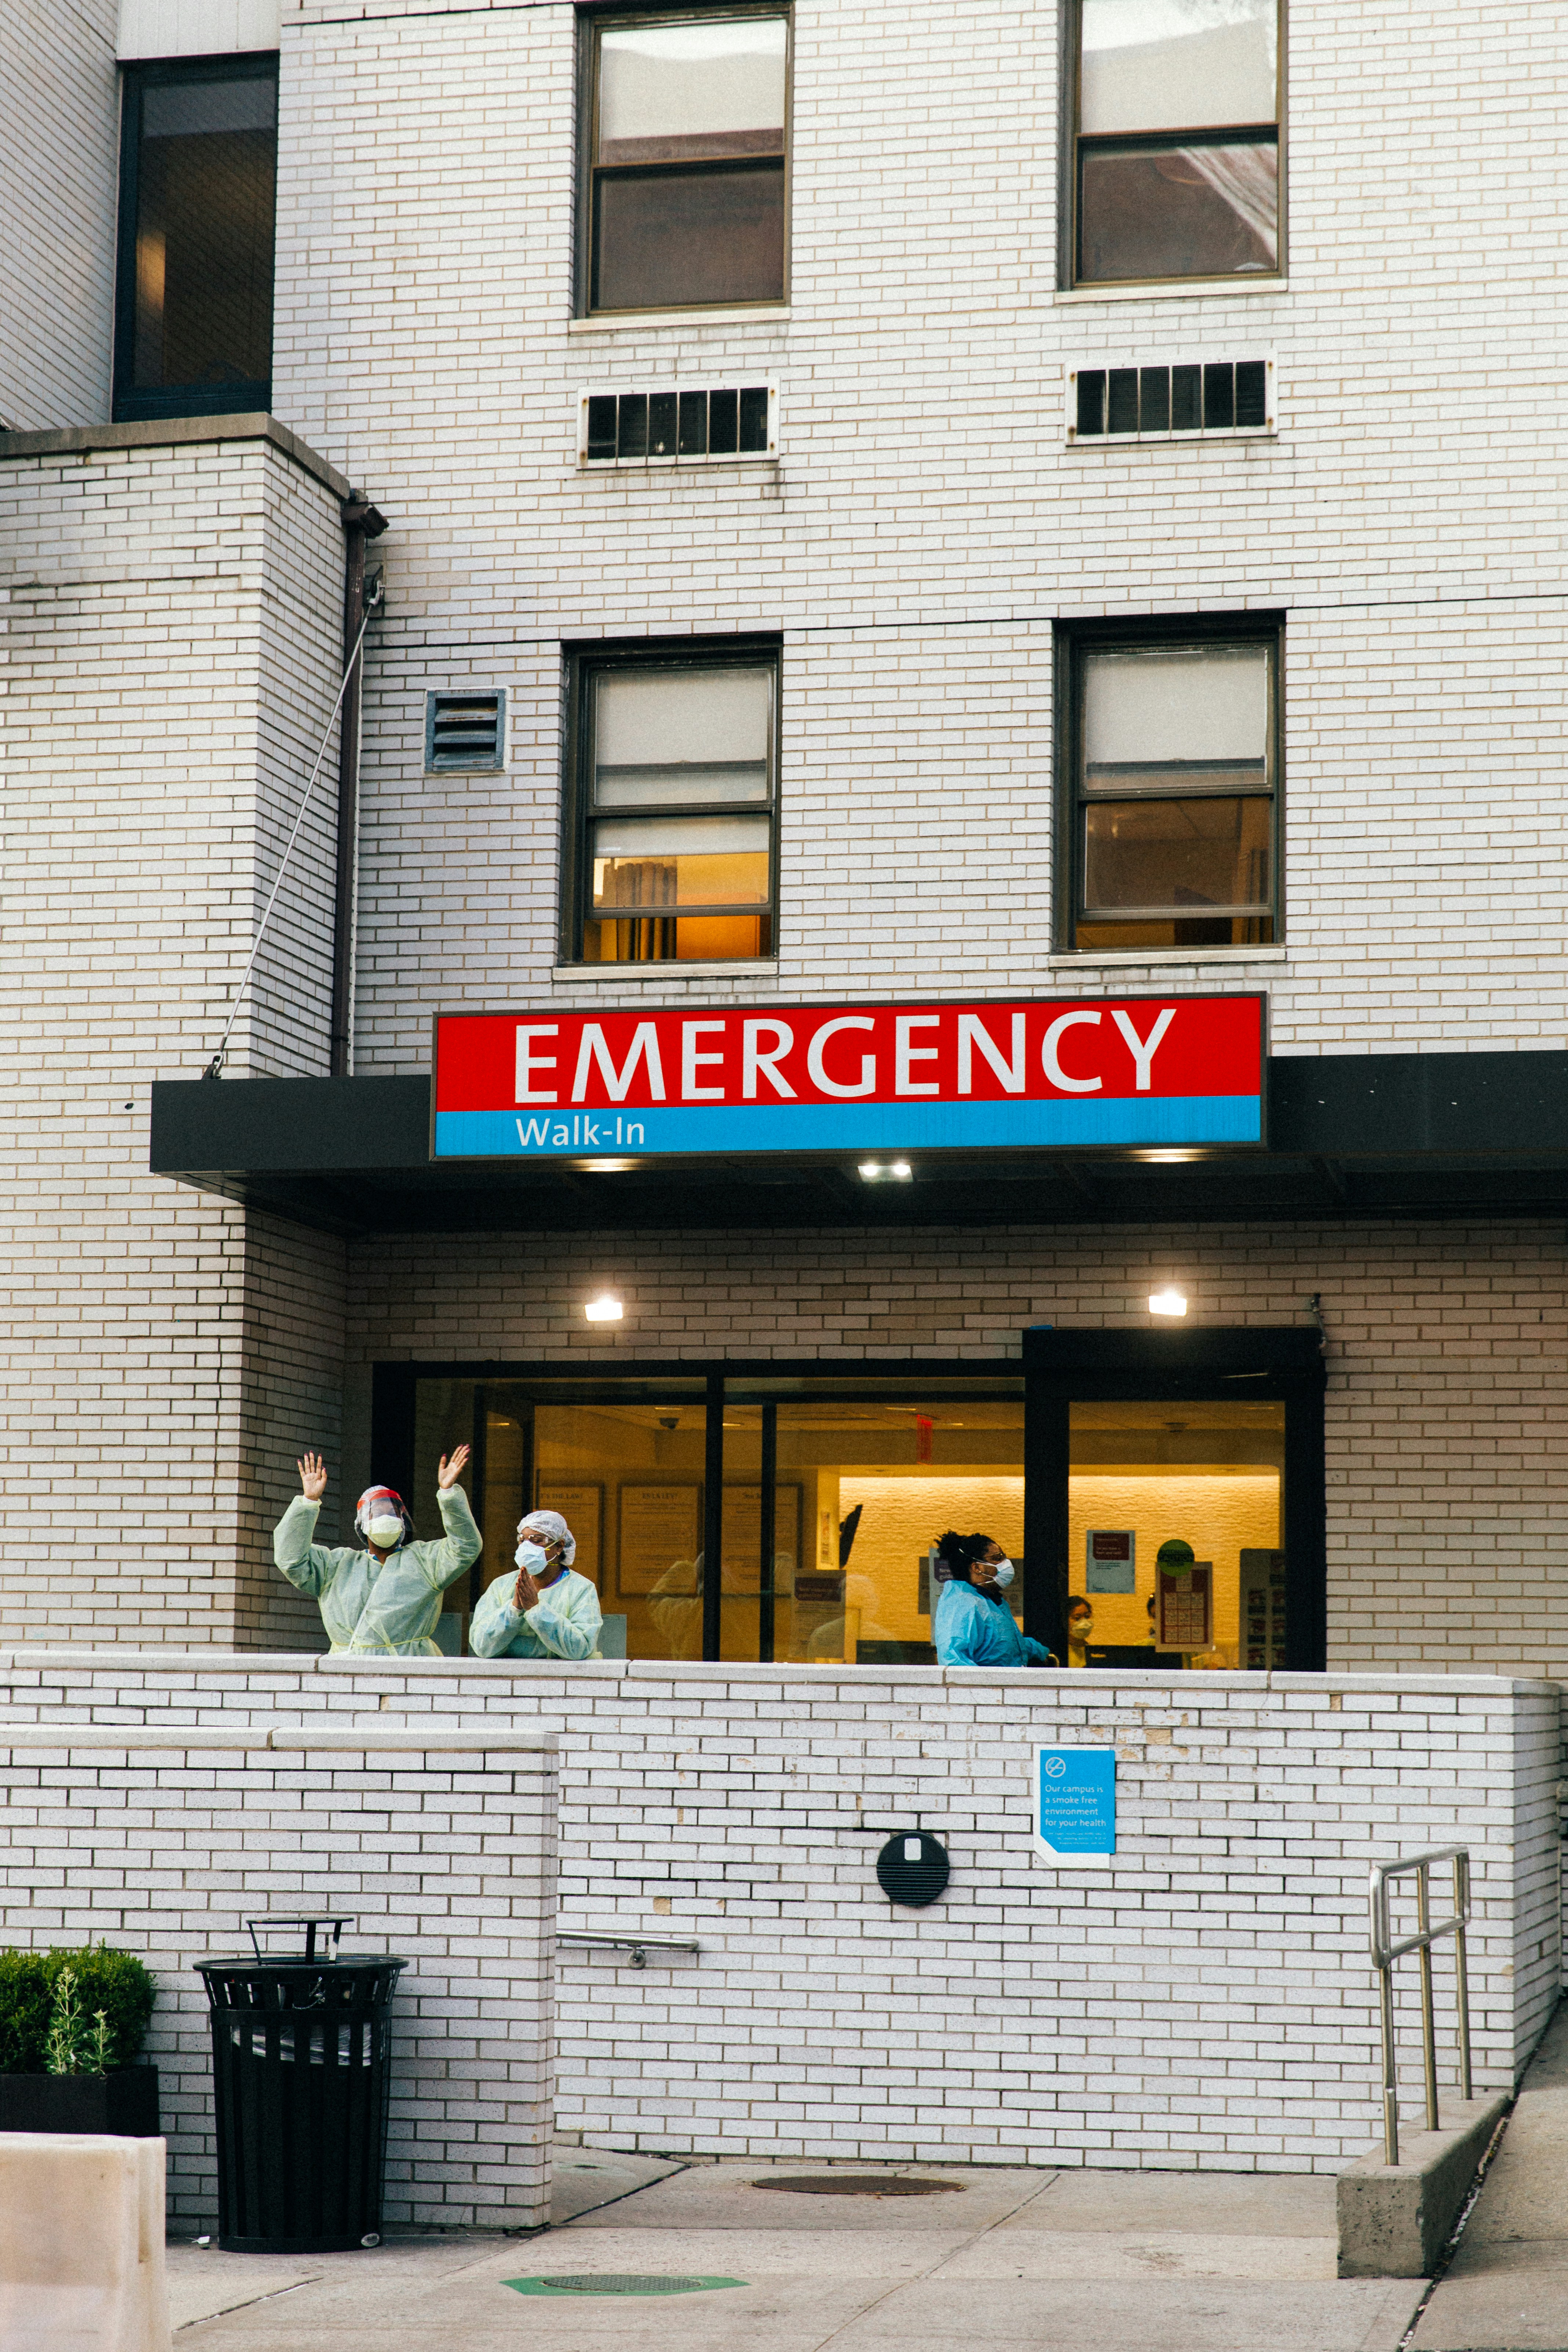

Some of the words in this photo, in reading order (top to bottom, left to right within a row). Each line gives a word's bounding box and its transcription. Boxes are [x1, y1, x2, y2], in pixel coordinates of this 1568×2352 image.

[515, 1009, 1177, 1103] EMERGENCY
[516, 1115, 644, 1146] Walk-In
[1045, 1818, 1056, 1826] for
[1059, 1820, 1078, 1828] your
[1080, 1819, 1107, 1827] health
